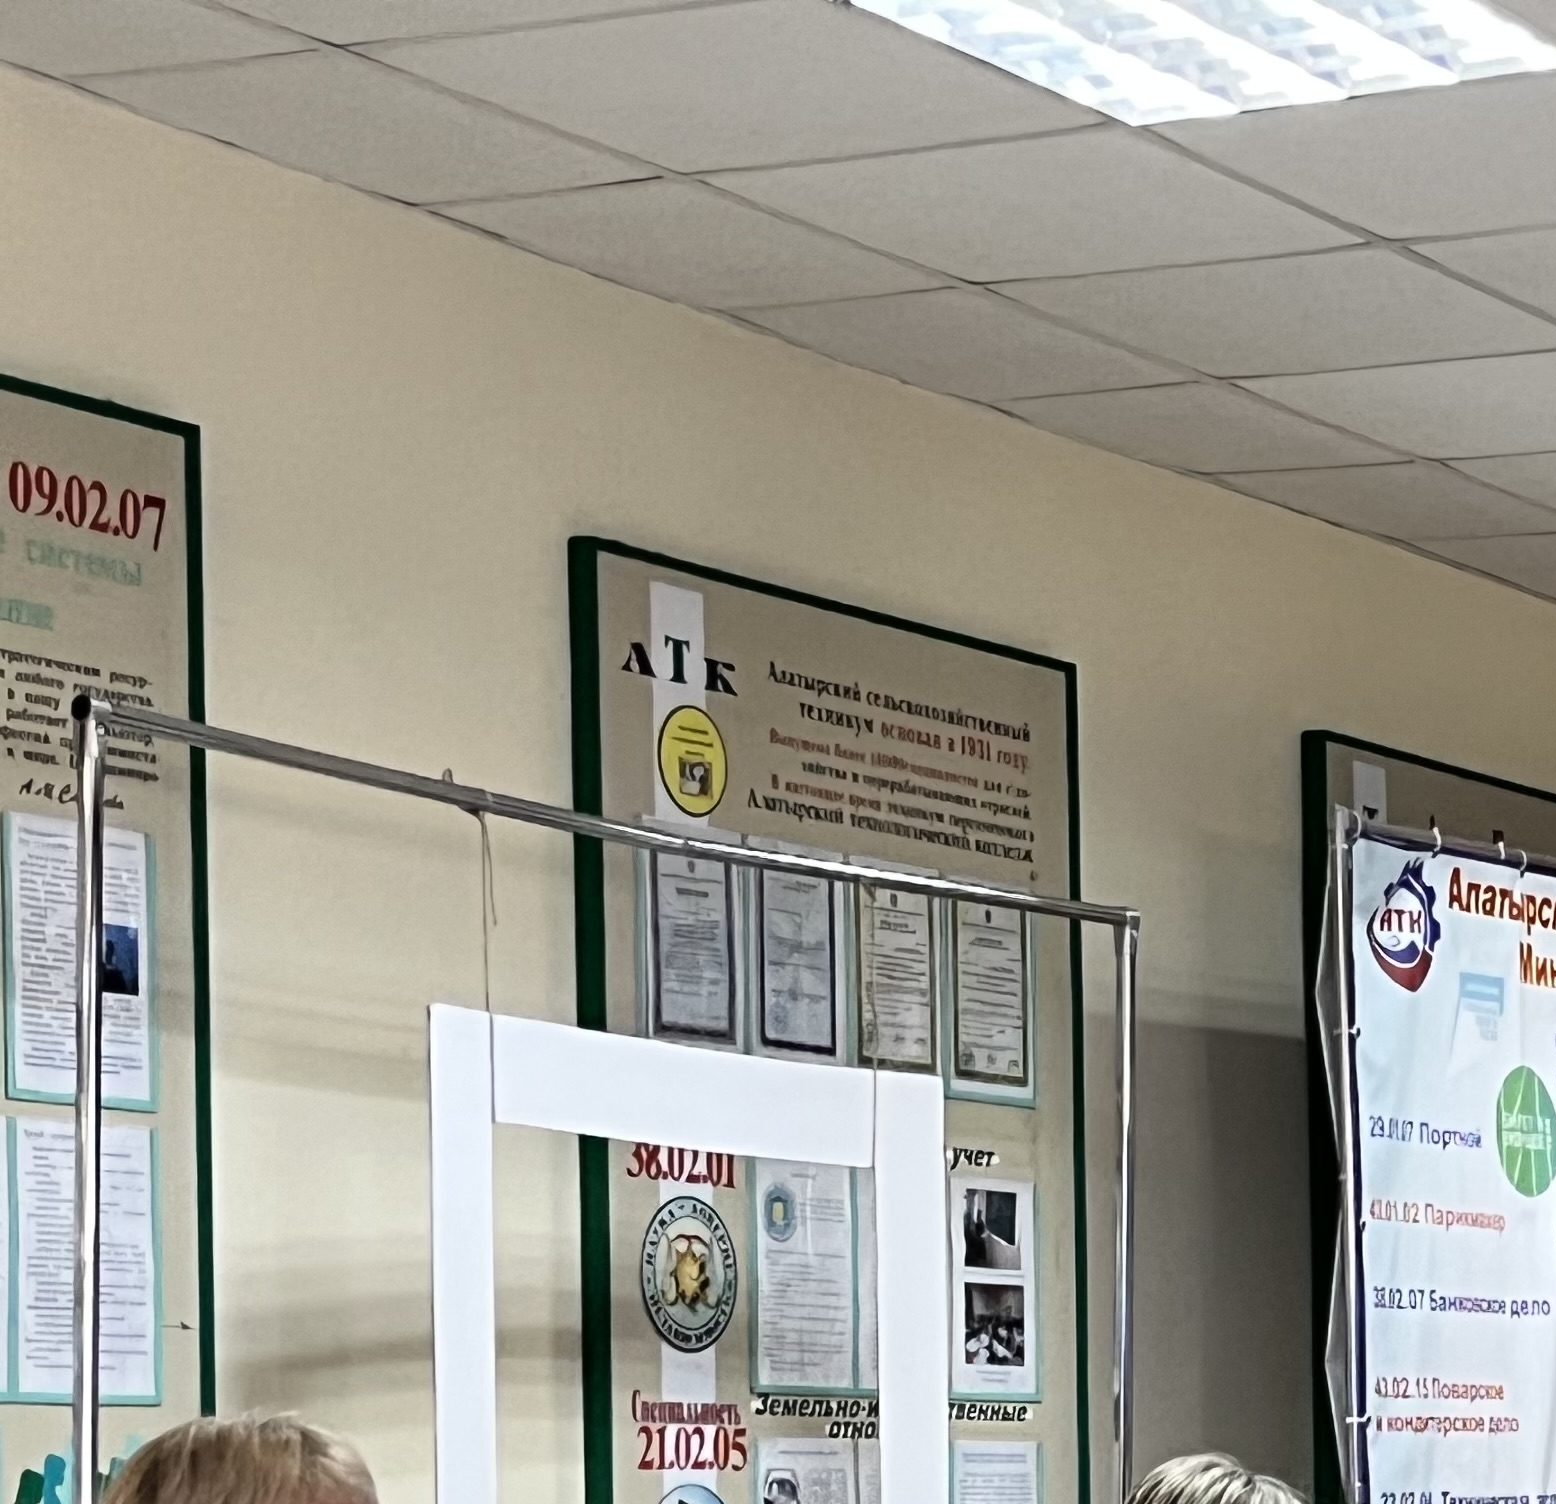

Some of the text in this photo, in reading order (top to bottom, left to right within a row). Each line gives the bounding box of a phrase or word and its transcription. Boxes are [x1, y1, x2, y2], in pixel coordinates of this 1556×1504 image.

[9, 461, 166, 552] 09.02.07
[961, 736, 991, 762] 1931
[997, 750, 1028, 774] году
[1380, 907, 1423, 934] АТК
[626, 1143, 736, 1189] 38.02.01
[950, 1147, 995, 1171] учет
[1510, 1298, 1551, 1319] дело
[636, 1426, 748, 1473] 21.02.05
